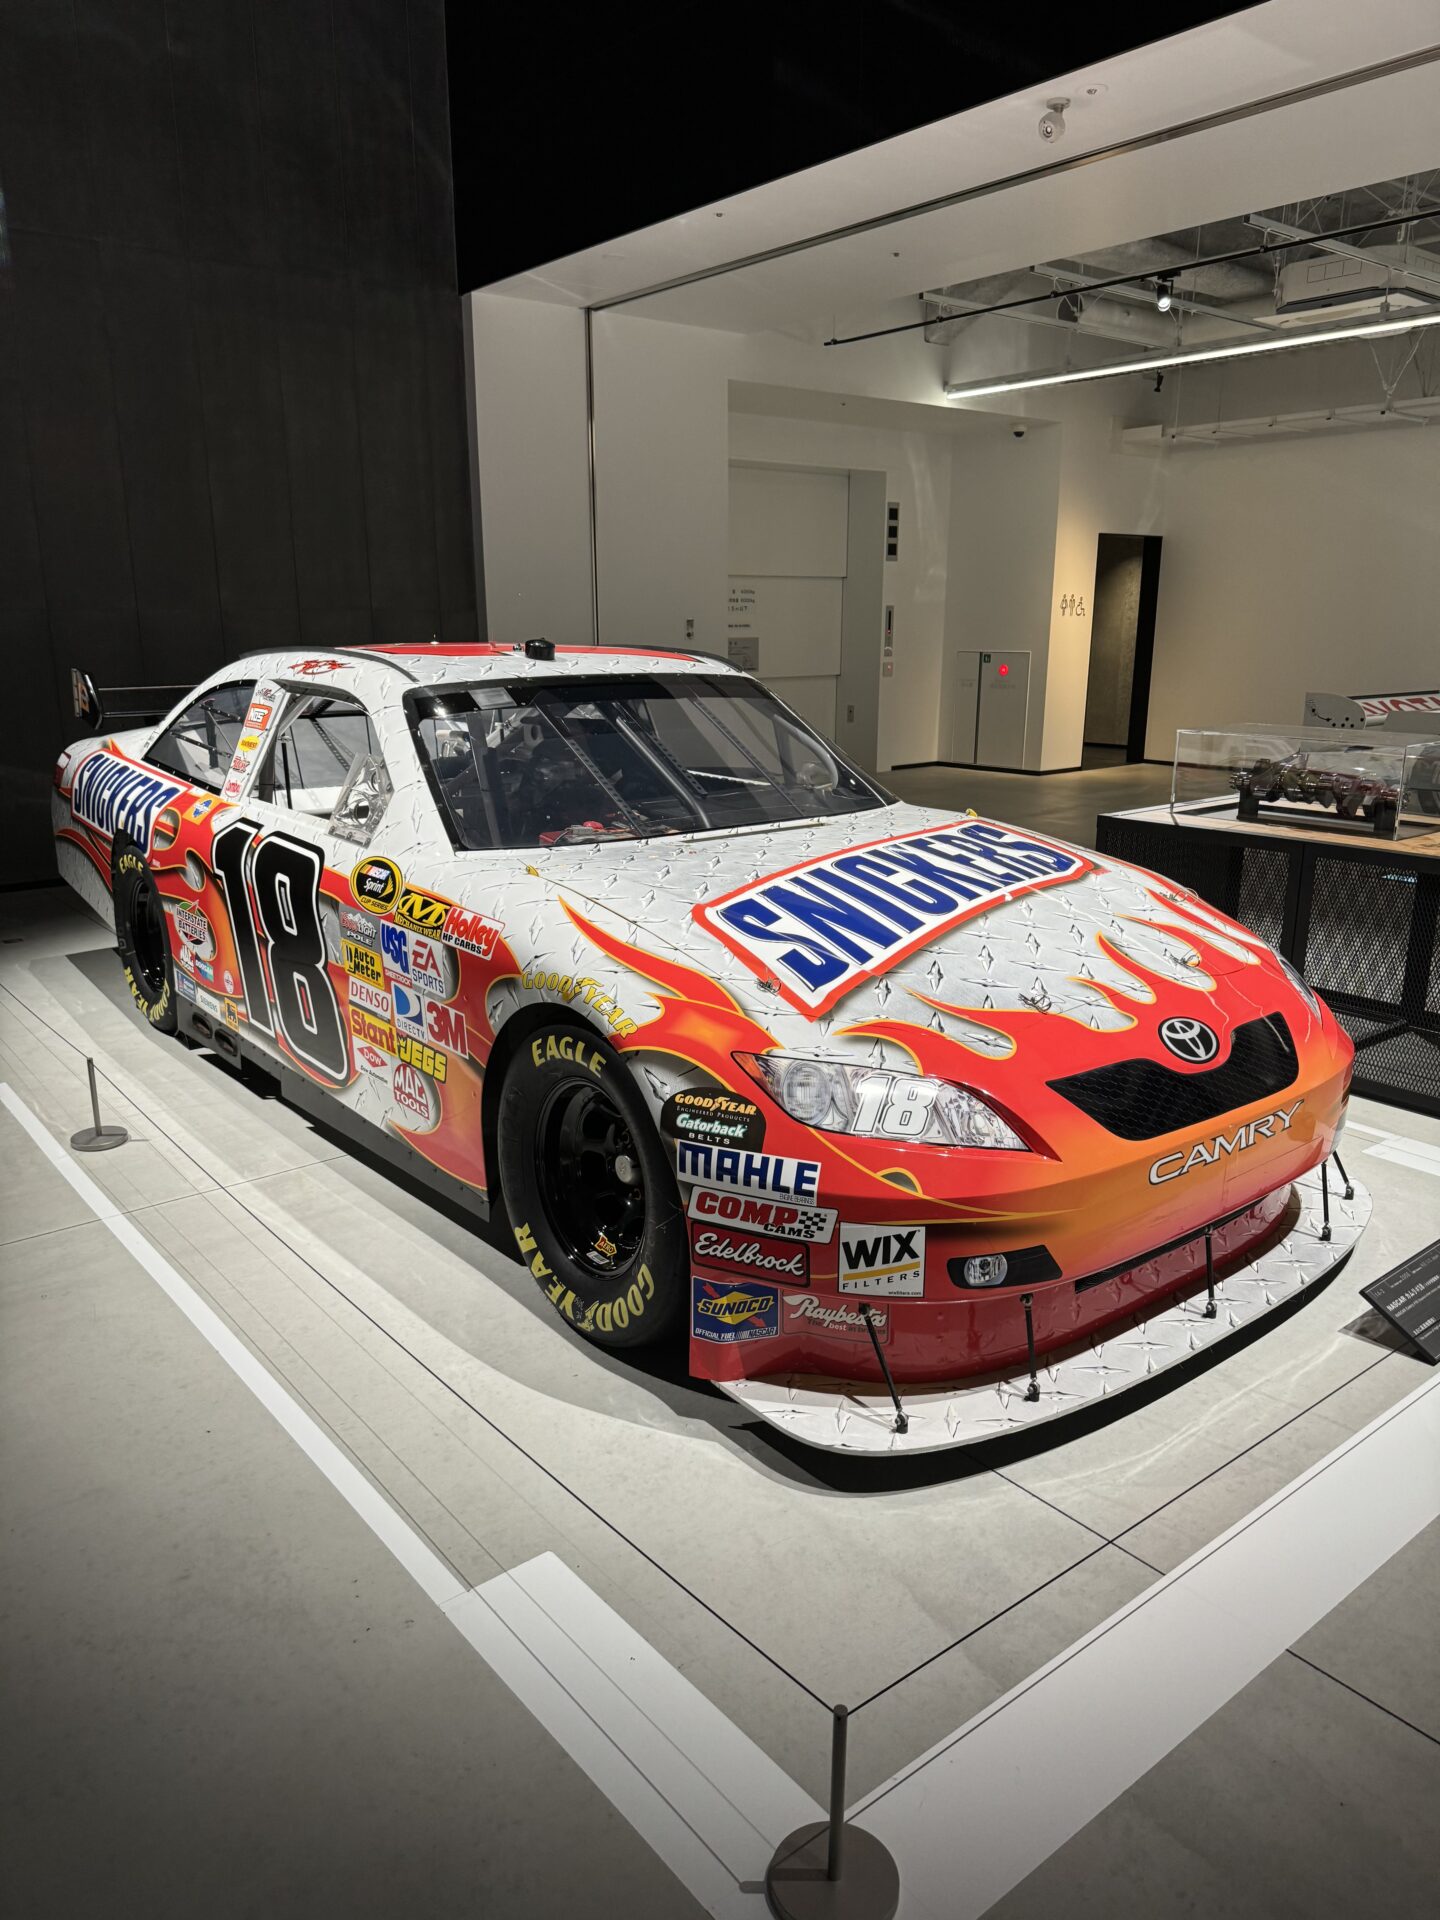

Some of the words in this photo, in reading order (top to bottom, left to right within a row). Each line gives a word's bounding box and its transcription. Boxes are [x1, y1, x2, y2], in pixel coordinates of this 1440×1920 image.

[74, 753, 180, 854] SNICKERS
[119, 854, 144, 874] EAGLE
[363, 878, 386, 893] Sprint
[360, 896, 371, 905] CUP
[370, 900, 388, 911] SERIES
[716, 824, 1078, 993] SNICKERS
[176, 907, 208, 930] INTERSTATE
[178, 920, 206, 941] BATTERIES
[357, 922, 377, 940] LIGHT
[445, 906, 499, 956] Holley
[346, 931, 373, 946] POLE
[422, 926, 442, 941] WEAR
[442, 932, 454, 945] HP
[454, 936, 482, 955] CARBS
[212, 818, 348, 1086] 18
[353, 947, 375, 967] Auto
[381, 923, 410, 976] USG
[412, 940, 442, 978] EA
[353, 959, 381, 982] Meter
[411, 968, 444, 994] SPORTS
[351, 981, 389, 1012] DENSO
[522, 969, 639, 1039] GOODYEAR
[350, 1008, 397, 1054] Stant
[426, 1000, 467, 1055] 3M
[399, 1037, 447, 1082] JEGS
[531, 1035, 607, 1078] EAGLE
[394, 1065, 427, 1105] MAC
[395, 1091, 429, 1118] TOOLS
[674, 1093, 757, 1116] GOODYEAR
[676, 1105, 714, 1116] ENGINEERED
[716, 1112, 750, 1123] PRODUCTS
[851, 1074, 939, 1138] 18
[676, 1113, 748, 1138] Gatorback
[688, 1132, 731, 1145] BELTS
[1149, 1098, 1305, 1187] CAMRY
[678, 1143, 818, 1198] MAHLE
[695, 1191, 799, 1228] COMP
[763, 1223, 816, 1239] CAMS
[694, 1232, 804, 1276] Edelbrock
[842, 1230, 920, 1270] WIX
[514, 1222, 655, 1333] GOODYEAR
[842, 1270, 920, 1290] FILTERS
[700, 1296, 773, 1316] SUNOCO
[1386, 1295, 1407, 1311] NASCAR
[695, 1327, 719, 1339] OFFICIAL
[720, 1331, 736, 1340] FUEL
[829, 1323, 847, 1331] best
